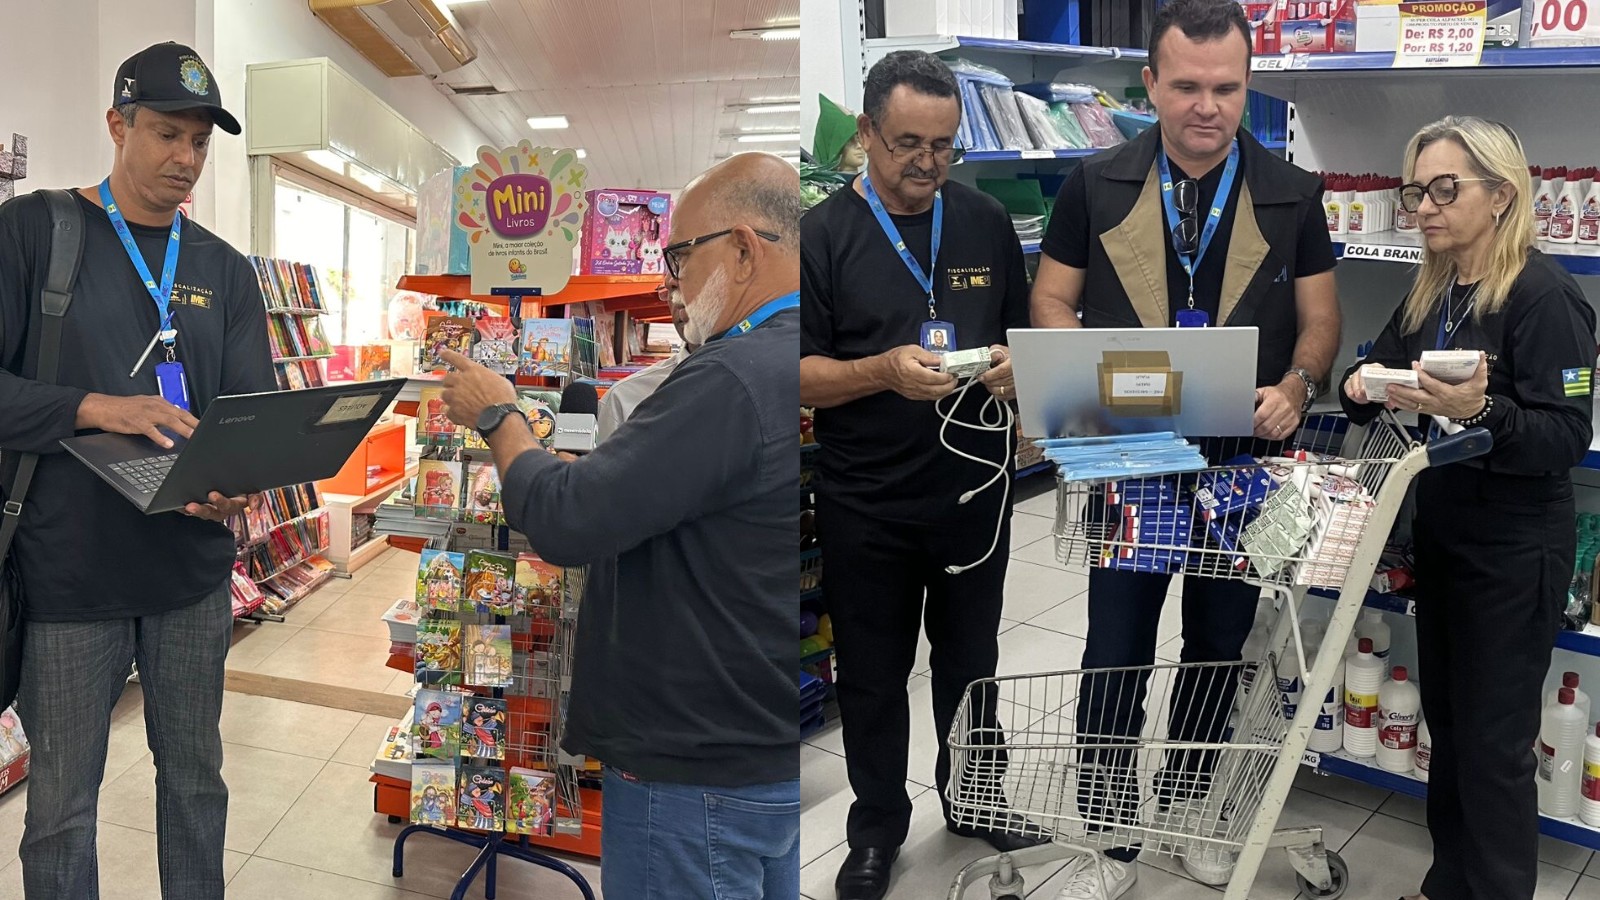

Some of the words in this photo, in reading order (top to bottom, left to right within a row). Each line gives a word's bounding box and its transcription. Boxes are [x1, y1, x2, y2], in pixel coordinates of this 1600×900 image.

[1411, 2, 1476, 14] PROMOÇÃO
[1405, 29, 1424, 39] De:
[1428, 28, 1444, 39] R$
[1447, 28, 1474, 40] 2,00
[1403, 43, 1426, 53] Por:
[1429, 42, 1444, 53] R$
[1448, 42, 1473, 53] 1,20
[1257, 60, 1283, 68] GEL
[493, 184, 545, 220] Mini
[506, 217, 535, 228] Livros
[1347, 246, 1379, 257] COLA
[174, 282, 213, 296] SCALIZAÇÃO
[218, 415, 256, 424] Lenovo
